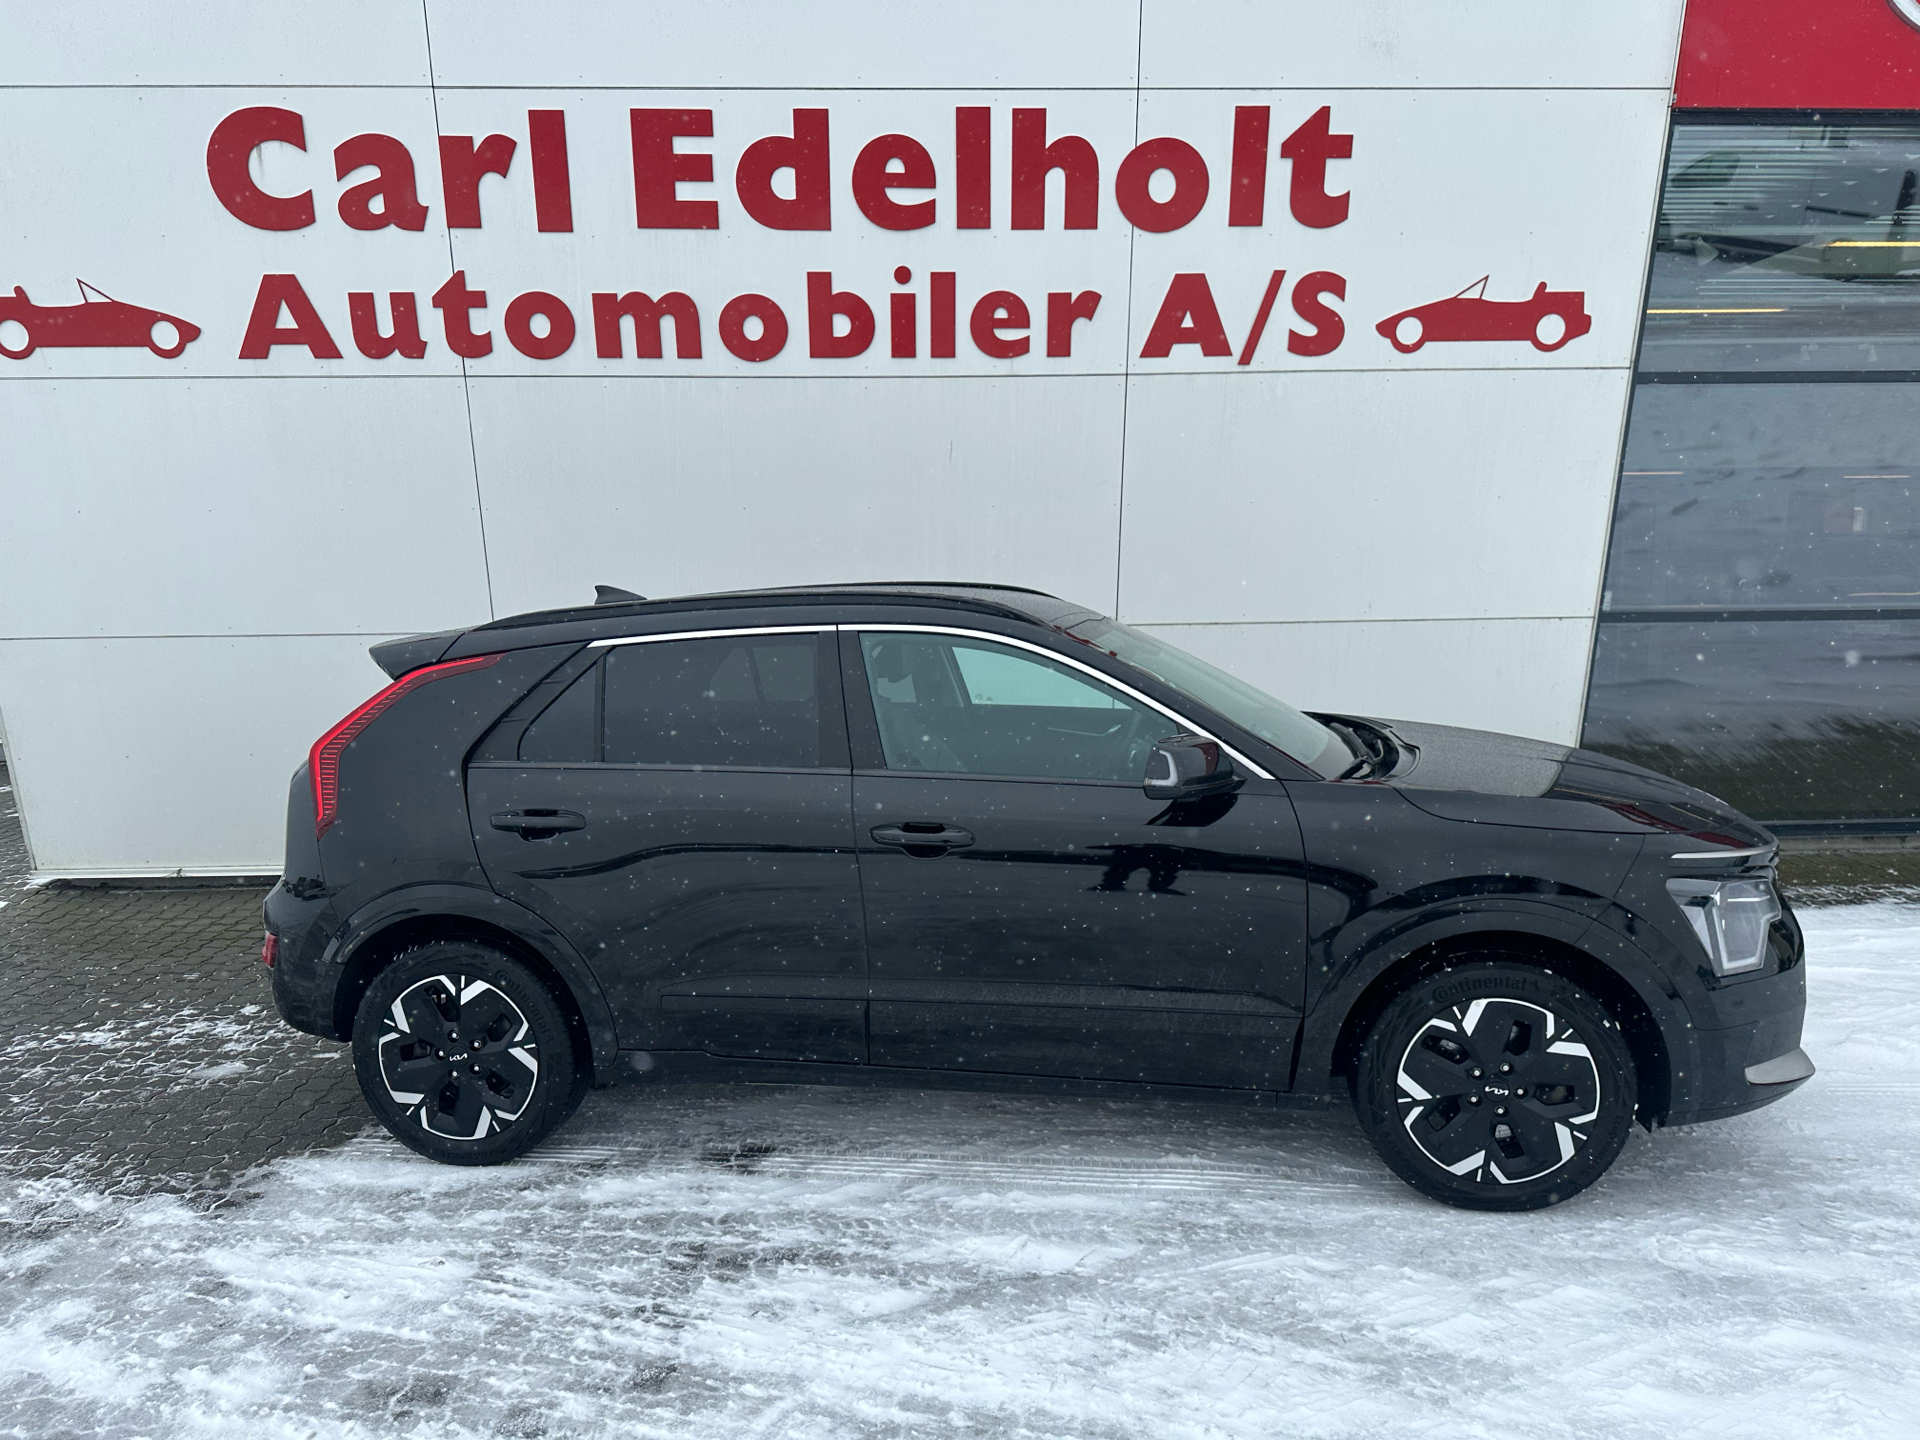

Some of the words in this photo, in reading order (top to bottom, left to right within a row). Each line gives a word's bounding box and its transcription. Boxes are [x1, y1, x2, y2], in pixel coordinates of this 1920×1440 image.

[207, 107, 572, 232] Carl
[630, 106, 1353, 232] Edelholt
[239, 266, 1101, 361] Automobiler
[1140, 270, 1345, 364] A/S
[493, 969, 551, 1033] Continental
[1431, 976, 1526, 1001] Continental
[449, 1052, 468, 1062] KIA
